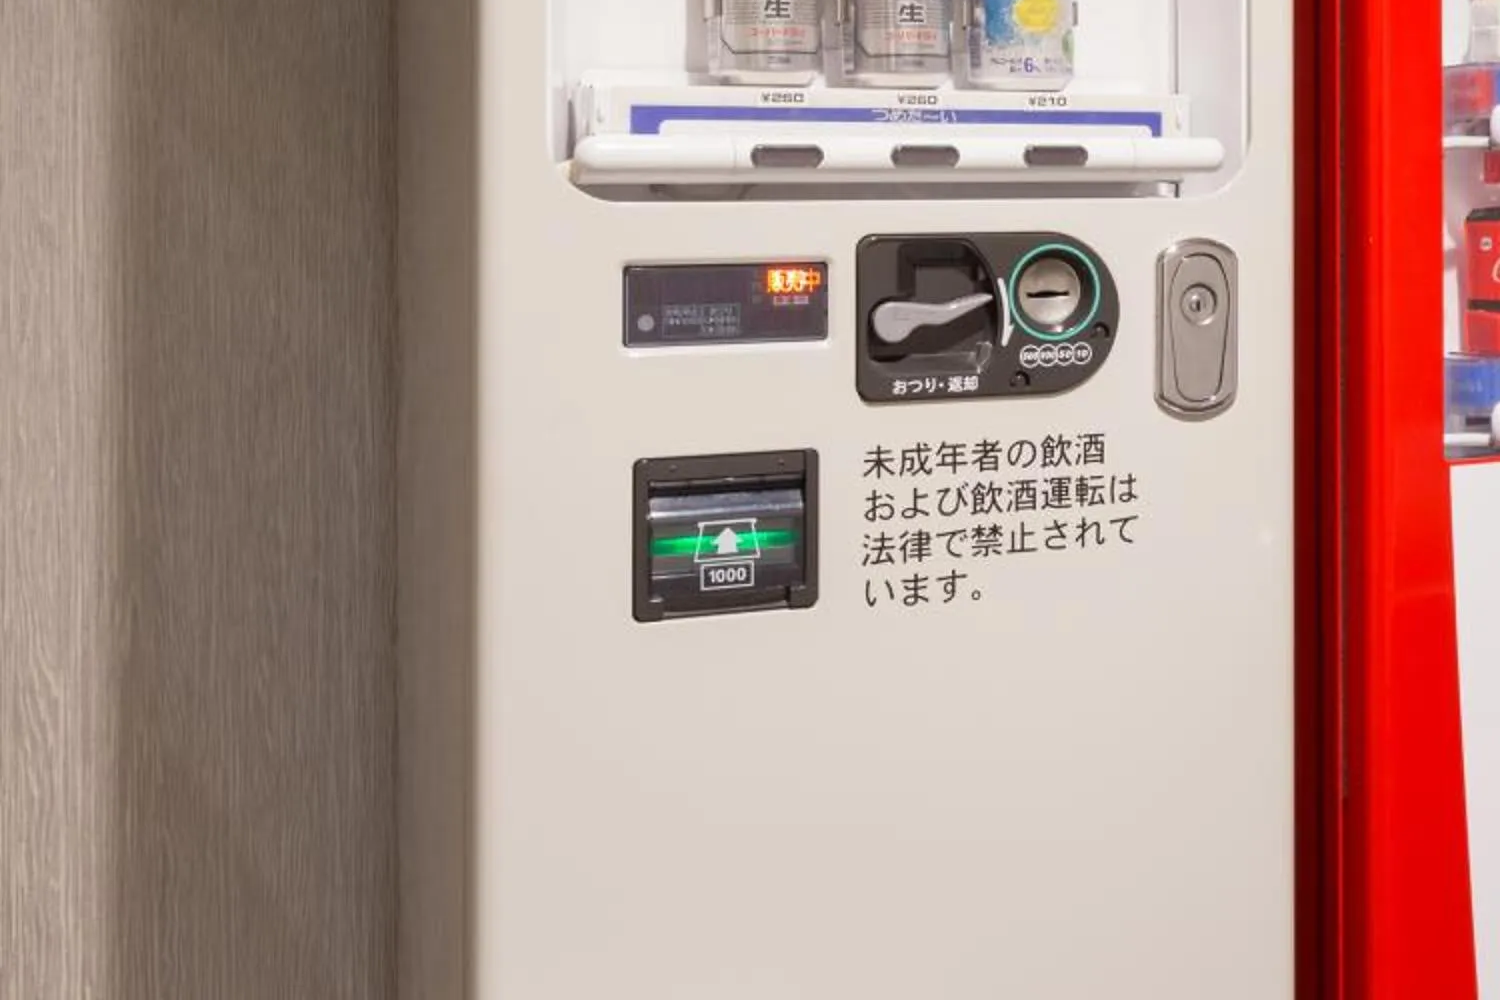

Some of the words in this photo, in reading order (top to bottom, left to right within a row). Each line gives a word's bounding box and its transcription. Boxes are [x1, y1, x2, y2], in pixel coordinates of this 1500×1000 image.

[764, 0, 791, 18] 生
[900, 4, 924, 22] 生
[761, 92, 805, 103] ¥260
[897, 94, 938, 105] ¥260
[1029, 95, 1067, 107] ¥210
[893, 375, 980, 395] おつり・返却
[863, 433, 1106, 478] 未成年者の飲酒
[864, 473, 1139, 523] および飲酒運転は
[862, 515, 1140, 567] 法律で禁止されて
[709, 565, 747, 584] 1000
[865, 572, 986, 607] います。
